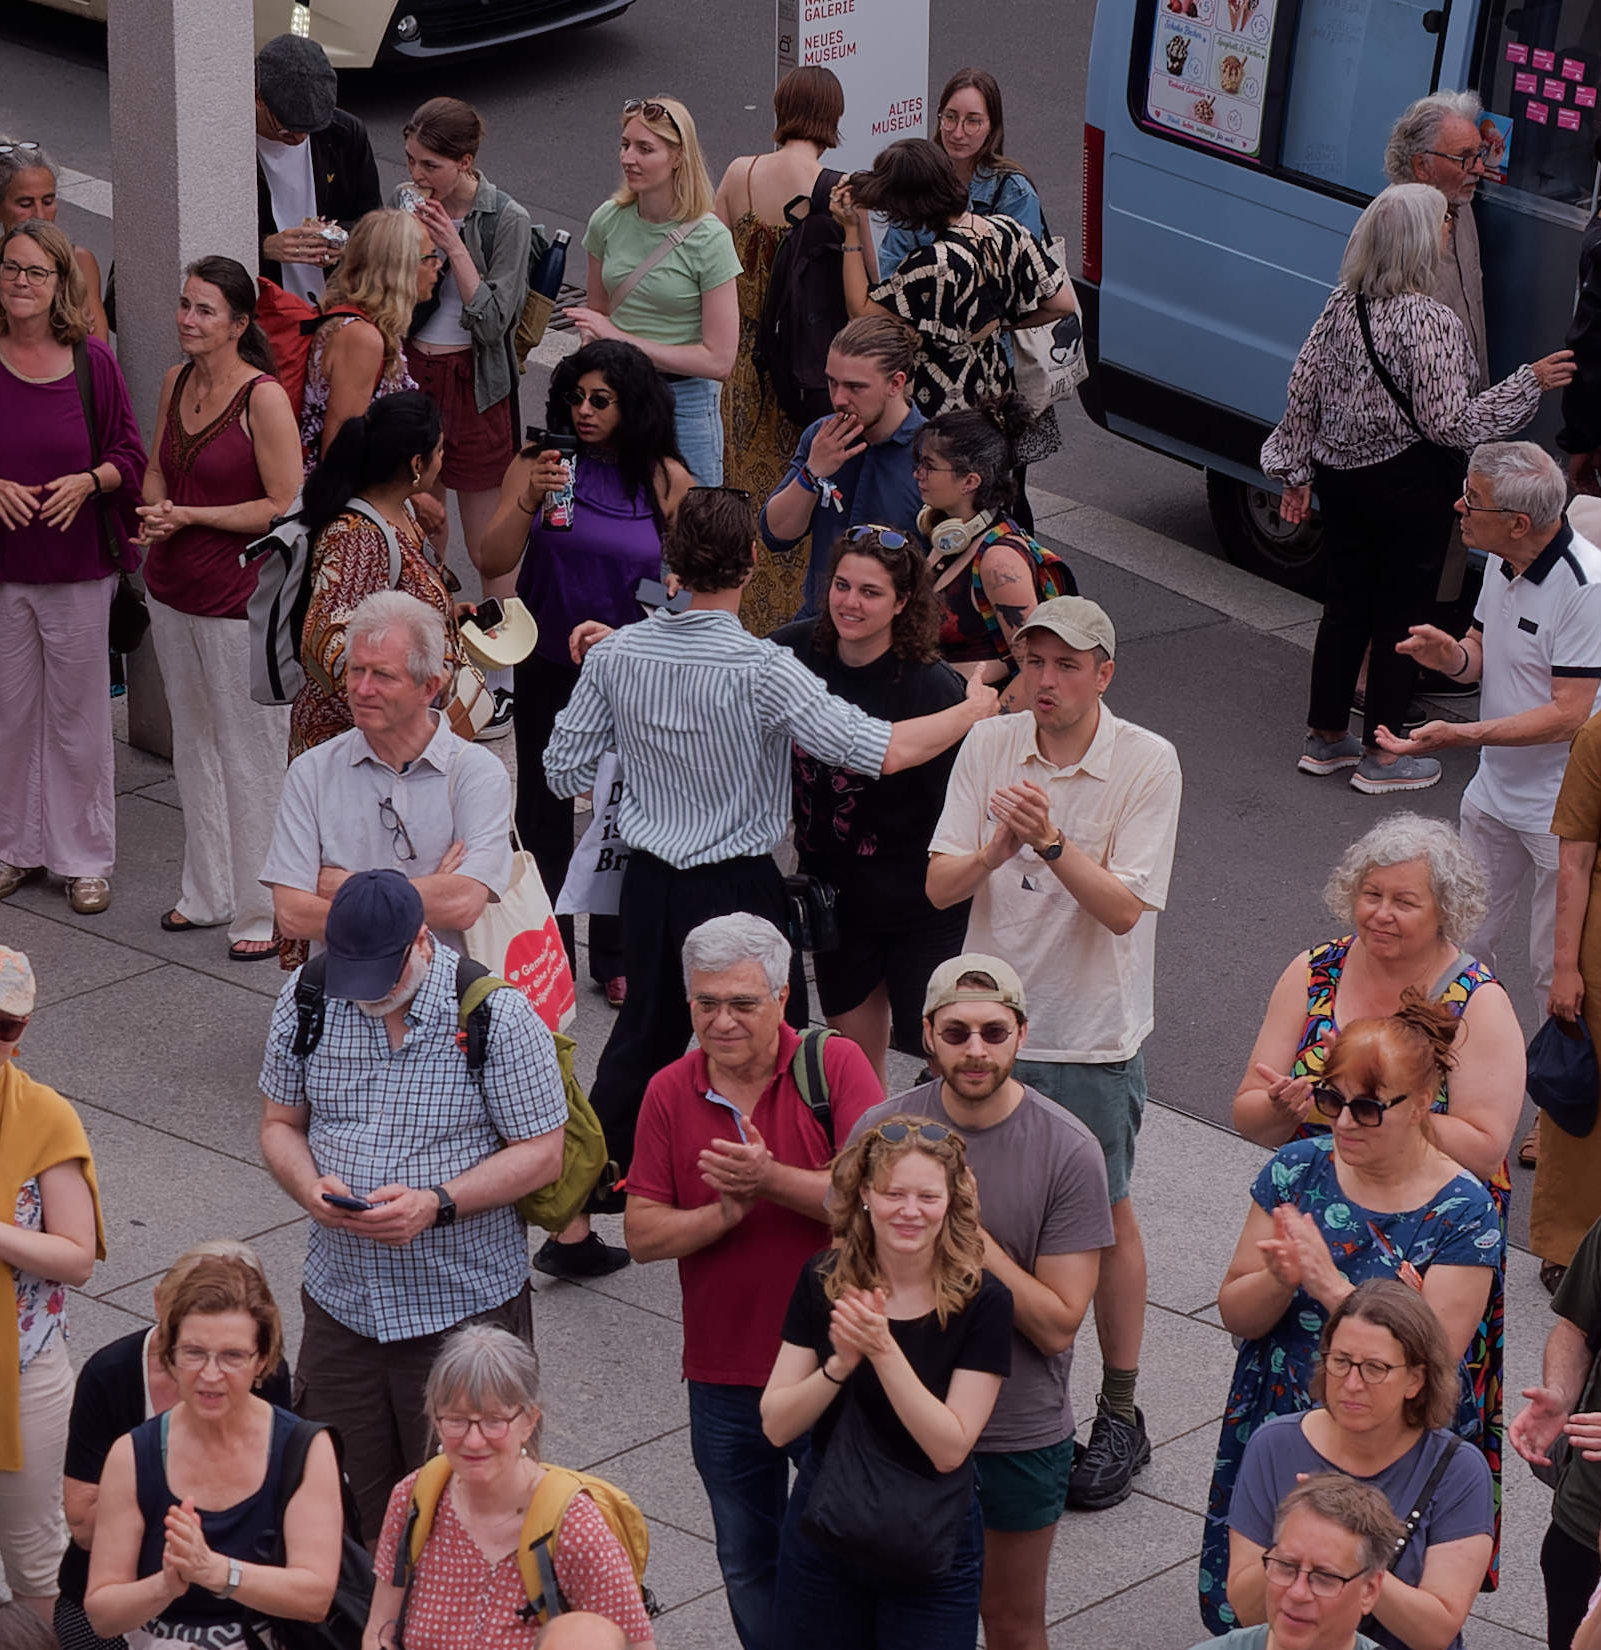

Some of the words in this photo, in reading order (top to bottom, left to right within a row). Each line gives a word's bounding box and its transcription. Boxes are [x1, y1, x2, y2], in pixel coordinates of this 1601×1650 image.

[805, 0, 855, 22] GALERIE
[805, 30, 843, 49] NEUES
[804, 42, 856, 66] MUSEUM
[888, 97, 923, 117] ALTES
[871, 113, 923, 136] MUSEUM
